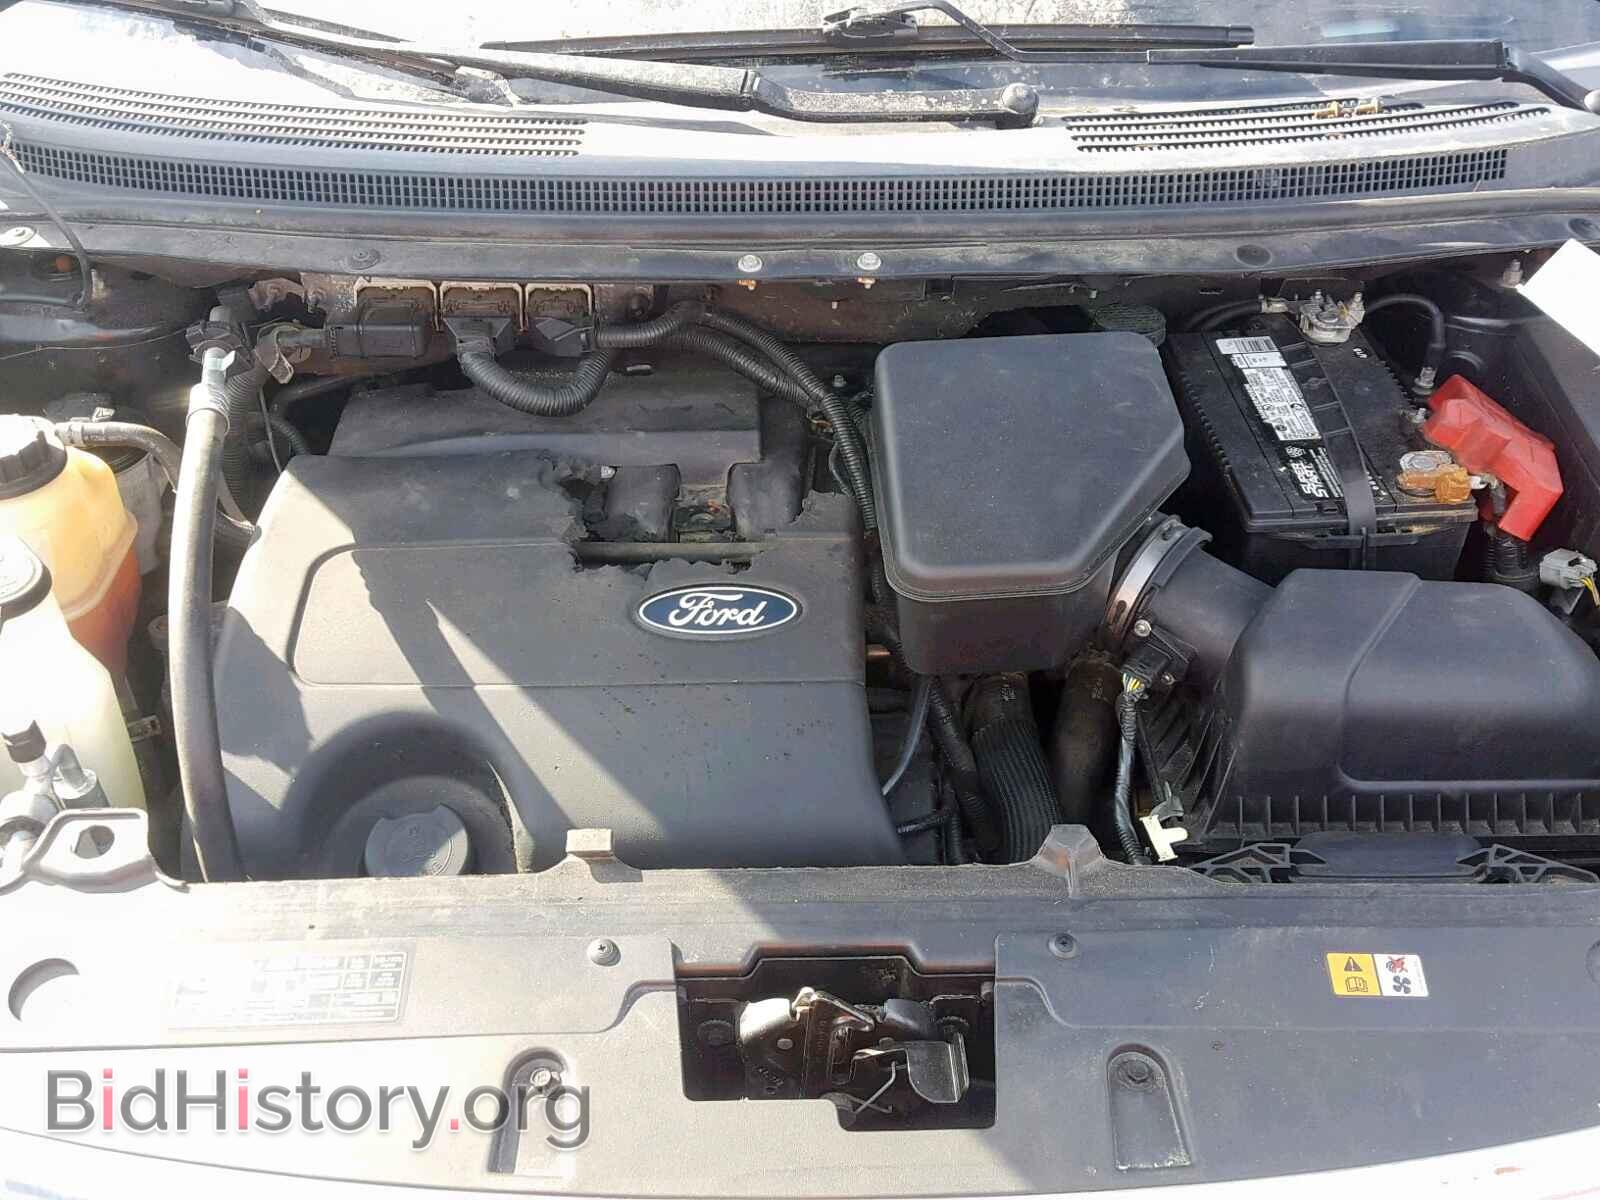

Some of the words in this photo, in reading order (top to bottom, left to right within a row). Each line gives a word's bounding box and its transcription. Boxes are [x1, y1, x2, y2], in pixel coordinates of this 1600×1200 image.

[1290, 461, 1312, 494] SUPER
[1304, 462, 1330, 497] START
[668, 593, 768, 626] Ford
